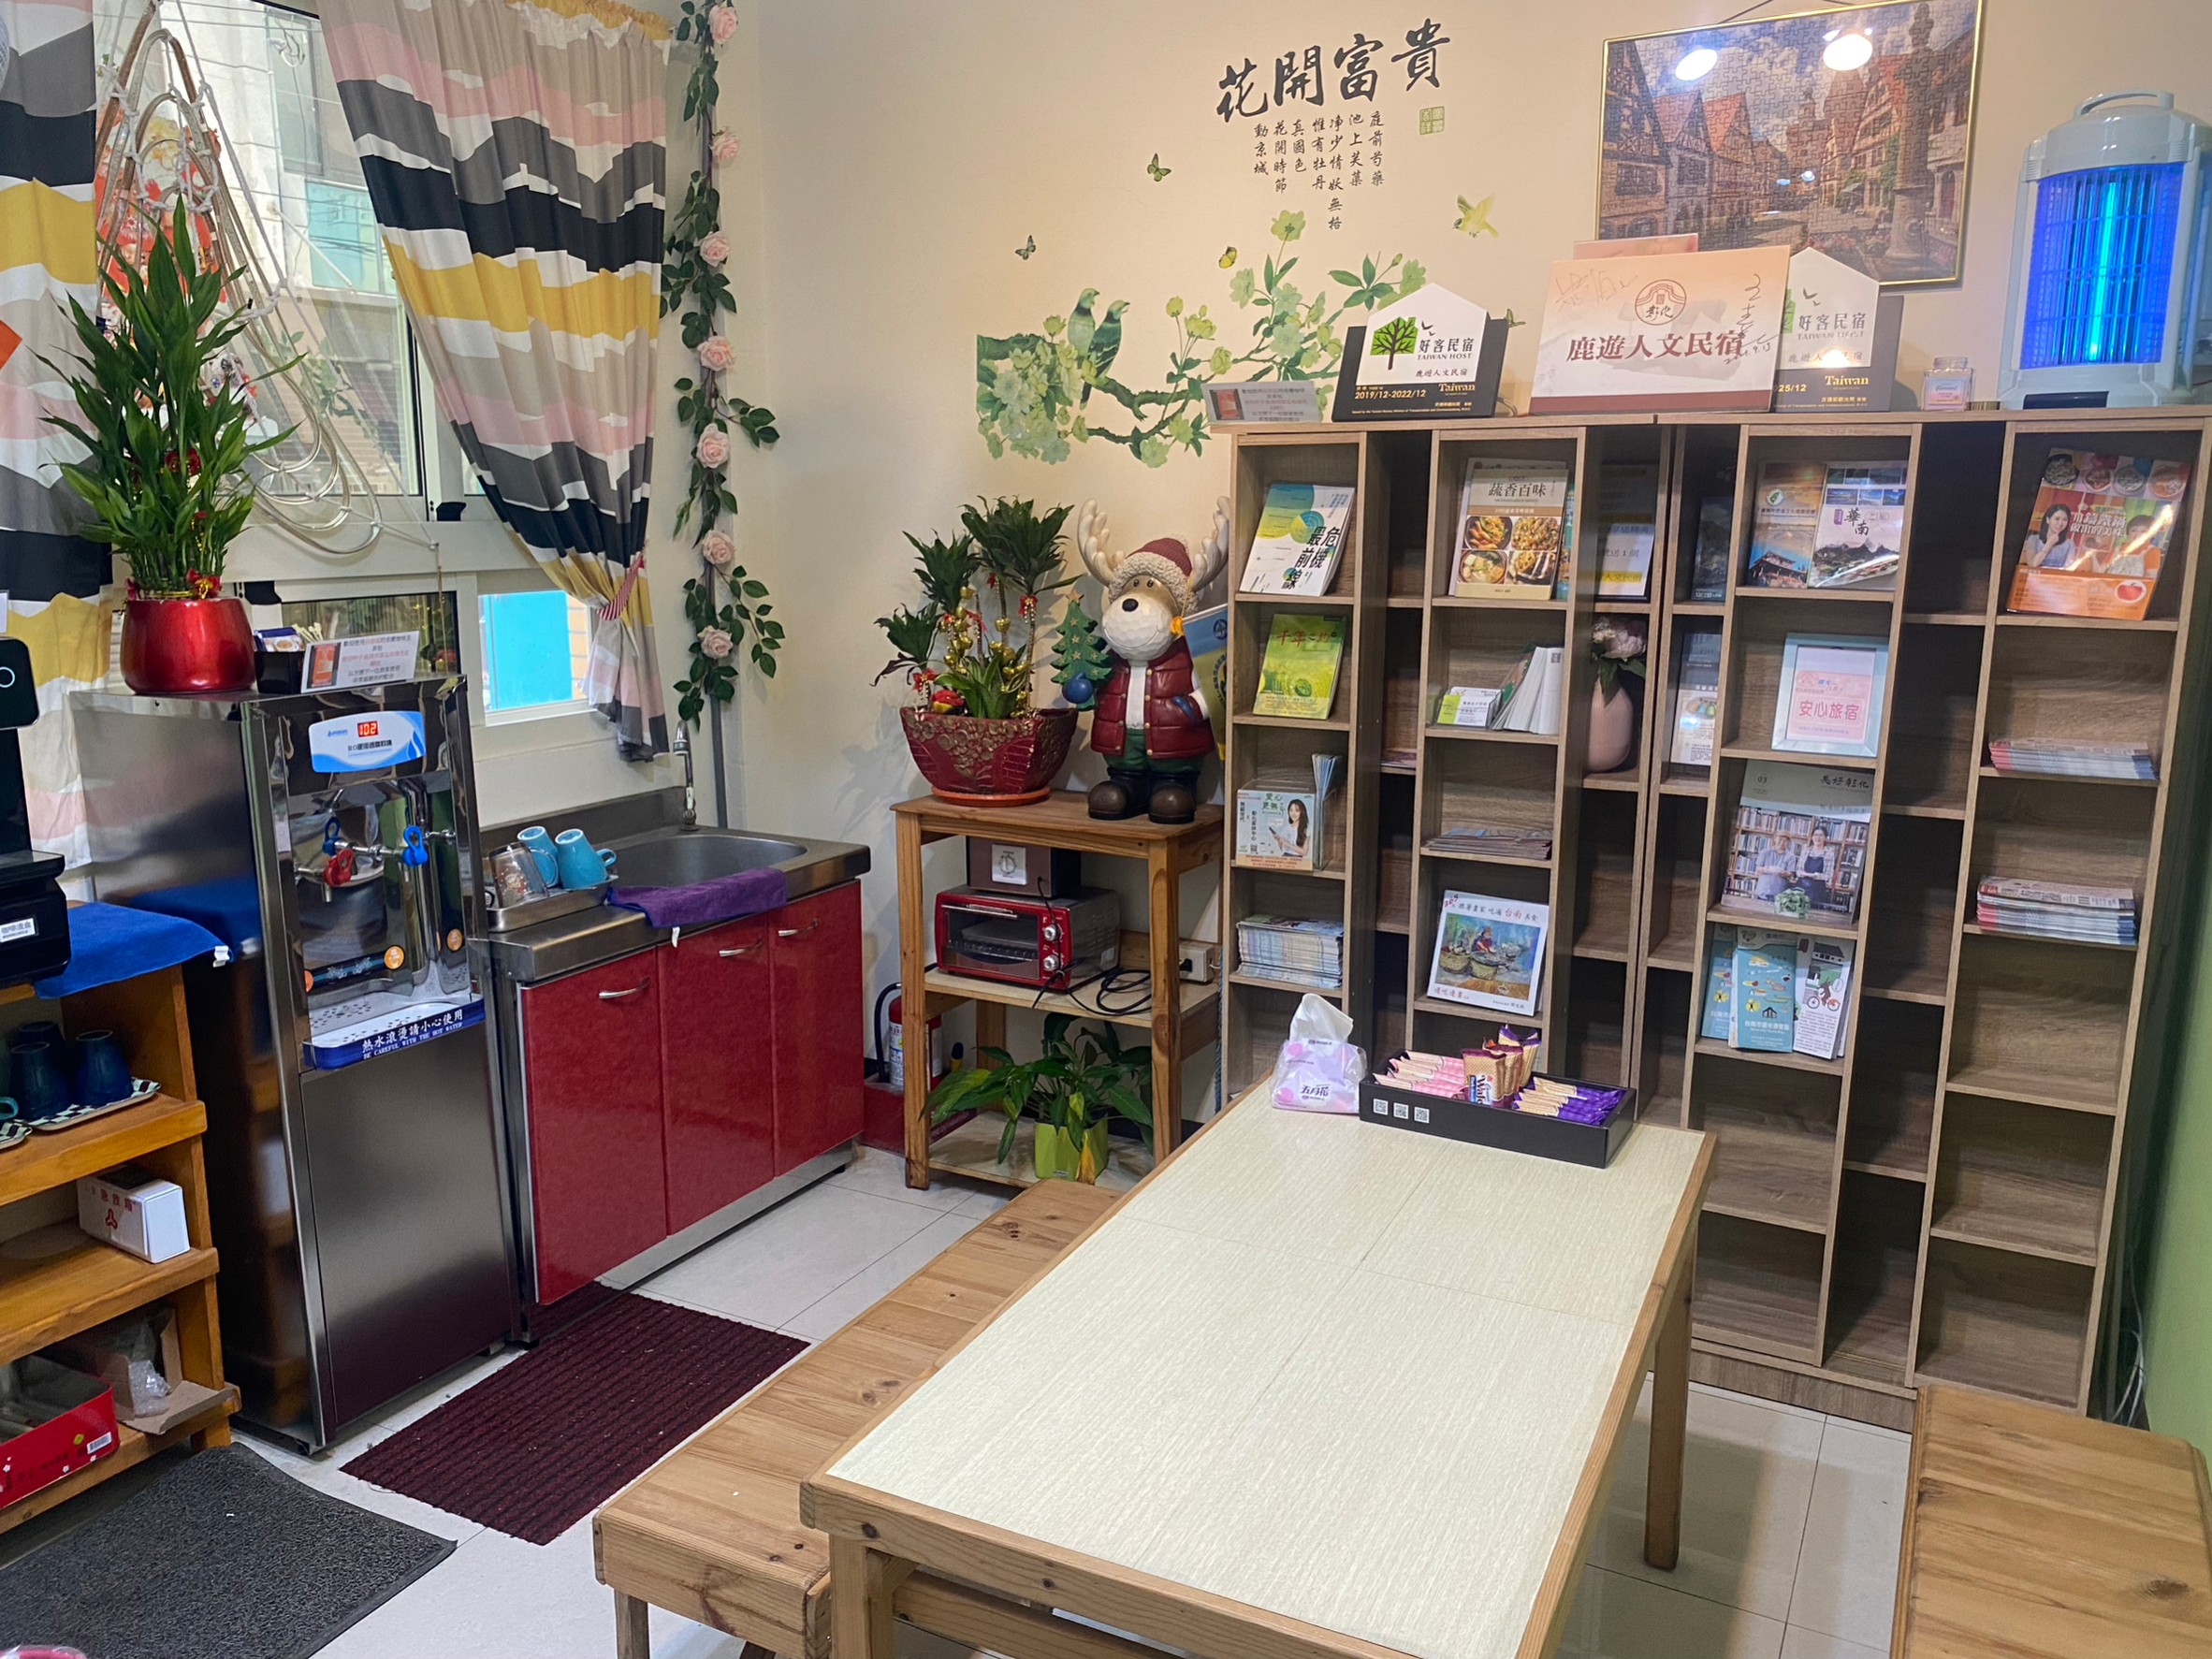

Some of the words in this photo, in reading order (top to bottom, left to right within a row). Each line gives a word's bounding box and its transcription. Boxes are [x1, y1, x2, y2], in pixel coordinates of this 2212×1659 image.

[1216, 18, 1450, 123] 花開富貴
[1253, 123, 1270, 176] 動京城
[1290, 118, 1307, 173] 真國色
[1368, 109, 1385, 187] 庭前芍藥
[1273, 119, 1288, 194] 花開時節
[1798, 313, 1867, 331] 好客民宿
[1419, 337, 1475, 354] 好客民宿
[1566, 329, 1746, 362] 鹿遊人文民宿
[1797, 332, 1835, 341] TAIWAN
[1438, 383, 1476, 392] Taiwan
[1825, 375, 1870, 386] Taiwan
[1354, 388, 1427, 400] 2019/12-2022/12
[1488, 482, 1547, 498] 蔬香百味
[1309, 526, 1342, 569] 危機
[1281, 526, 1327, 589] 最前線
[1798, 700, 1859, 720] 安心旅宿
[359, 723, 376, 735] 102
[1757, 775, 1768, 784] 03
